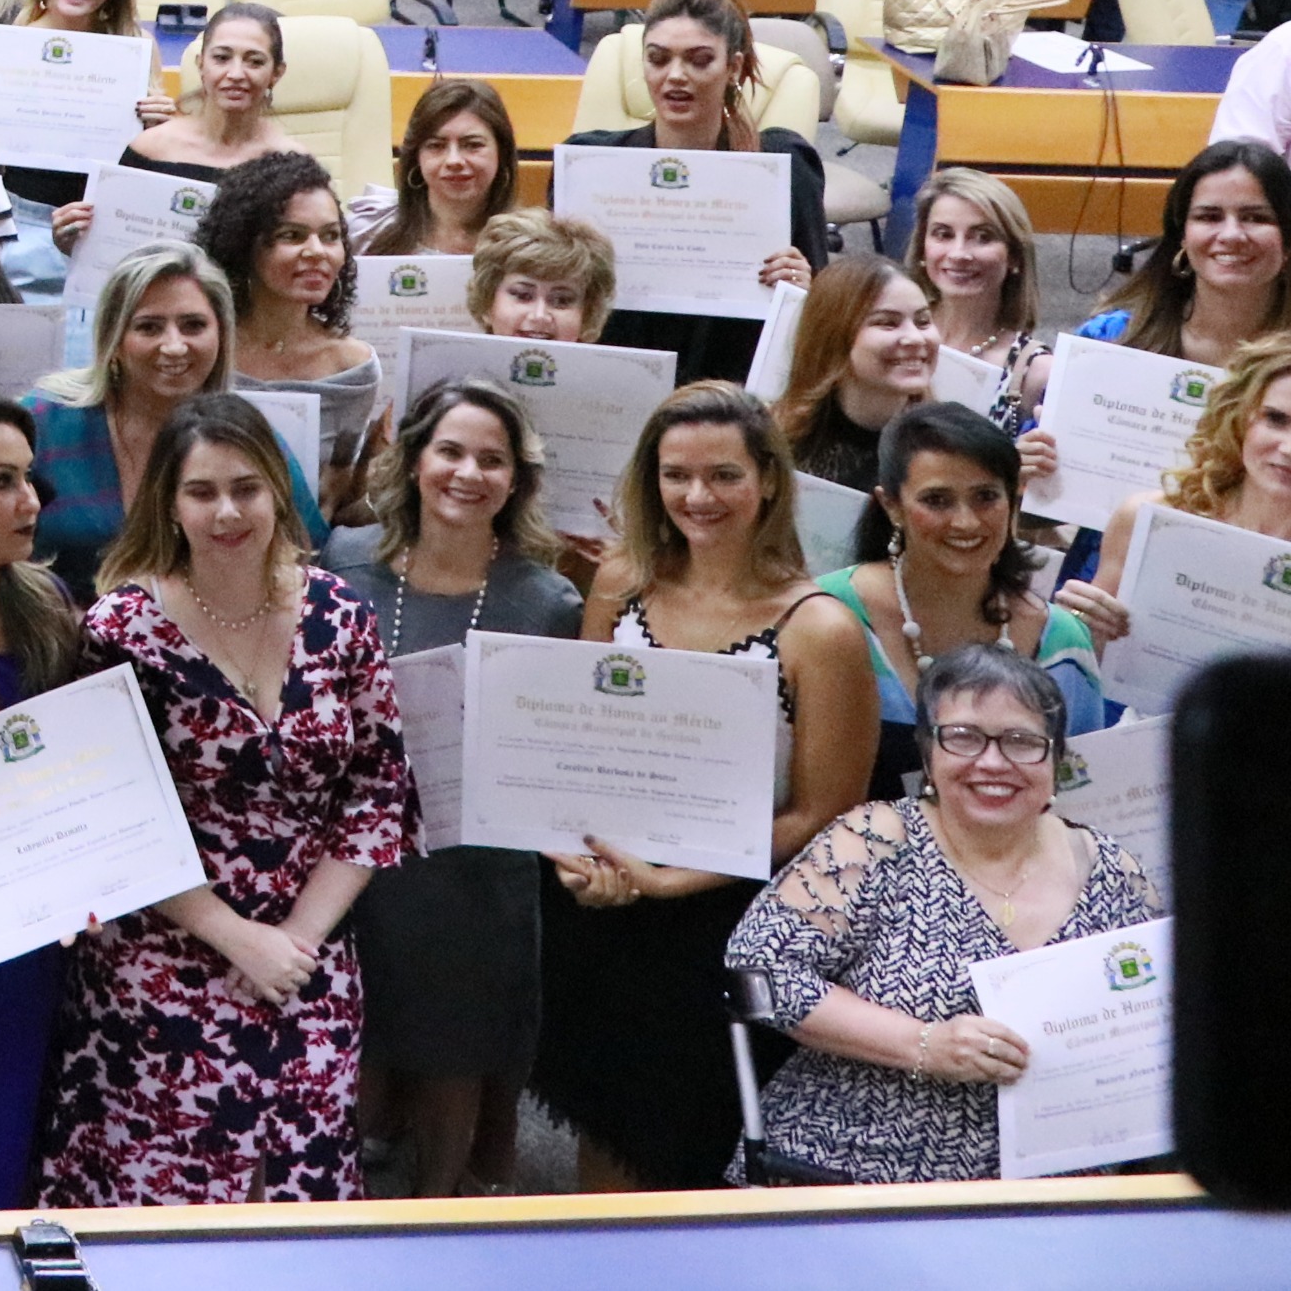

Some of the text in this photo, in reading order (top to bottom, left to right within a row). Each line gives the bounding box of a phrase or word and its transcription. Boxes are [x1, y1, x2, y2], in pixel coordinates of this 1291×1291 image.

[1092, 393, 1146, 416] Diploma
[1175, 572, 1235, 600] Diploma
[515, 695, 721, 729] Diploma de Honra ao Mérito
[1042, 1013, 1098, 1035] Diploma
[1102, 1007, 1116, 1020] de
